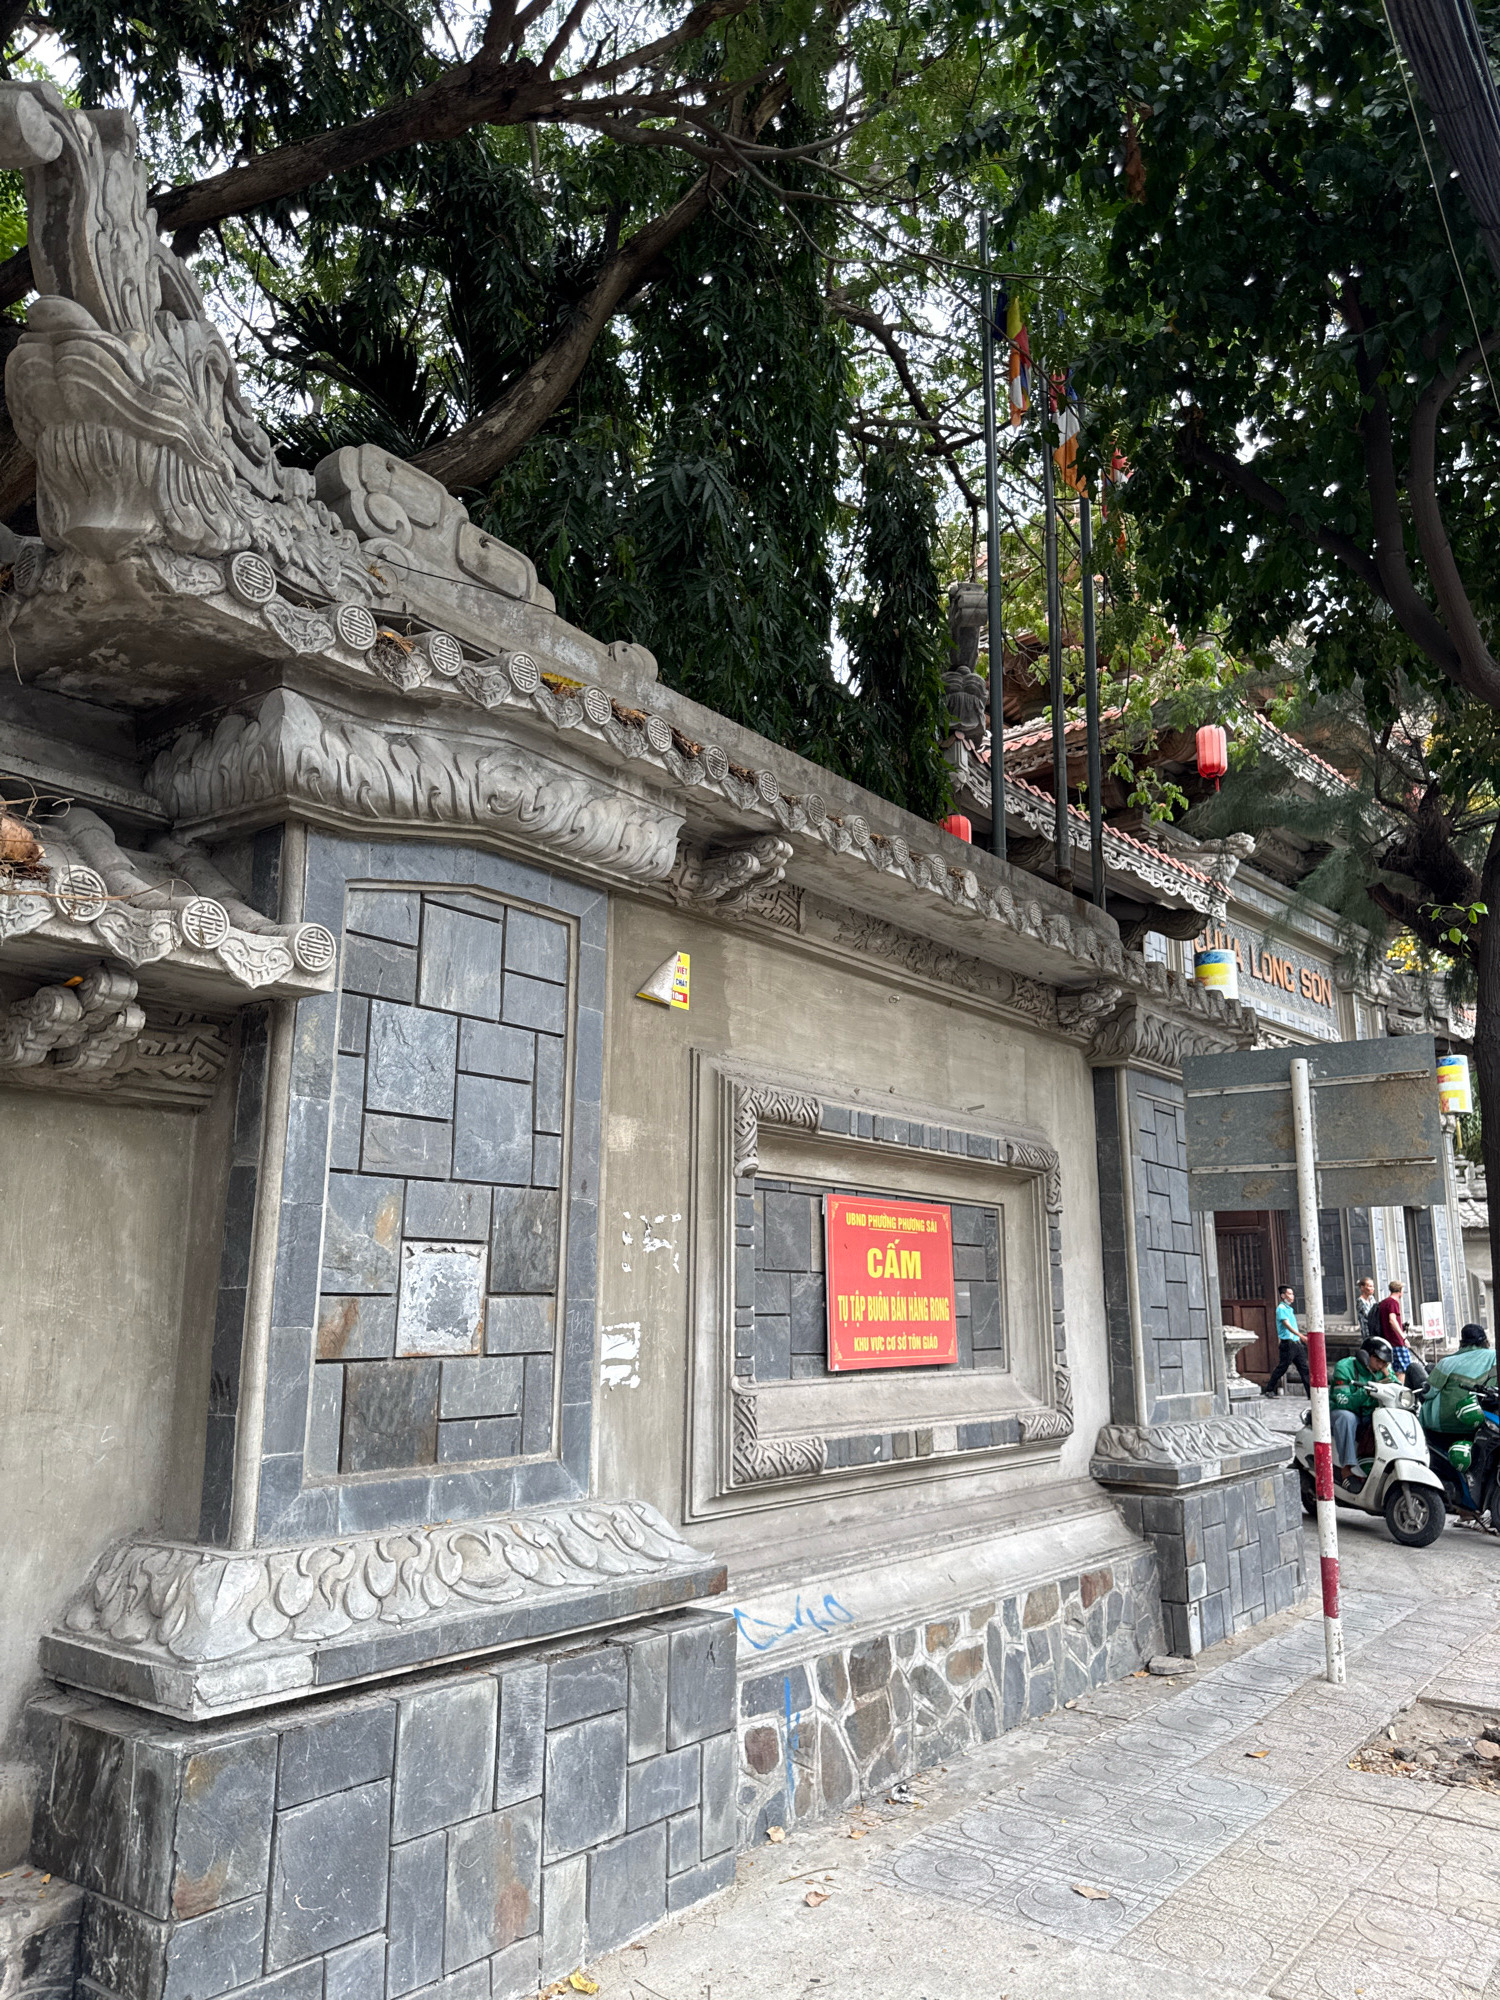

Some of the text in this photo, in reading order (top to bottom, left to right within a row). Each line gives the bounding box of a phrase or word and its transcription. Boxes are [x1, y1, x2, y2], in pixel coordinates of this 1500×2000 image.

[1250, 944, 1296, 993] LONG
[846, 1212, 938, 1233] UBND PHƯỜNG PHƯƠNG SÀI
[867, 1239, 922, 1280] CẤM
[838, 1289, 950, 1328] TỤ TẬP BUÔN BÁN HÀNG RONG
[854, 1331, 938, 1354] KHU VỰC CƠ SỞ TÔN GIÁO
